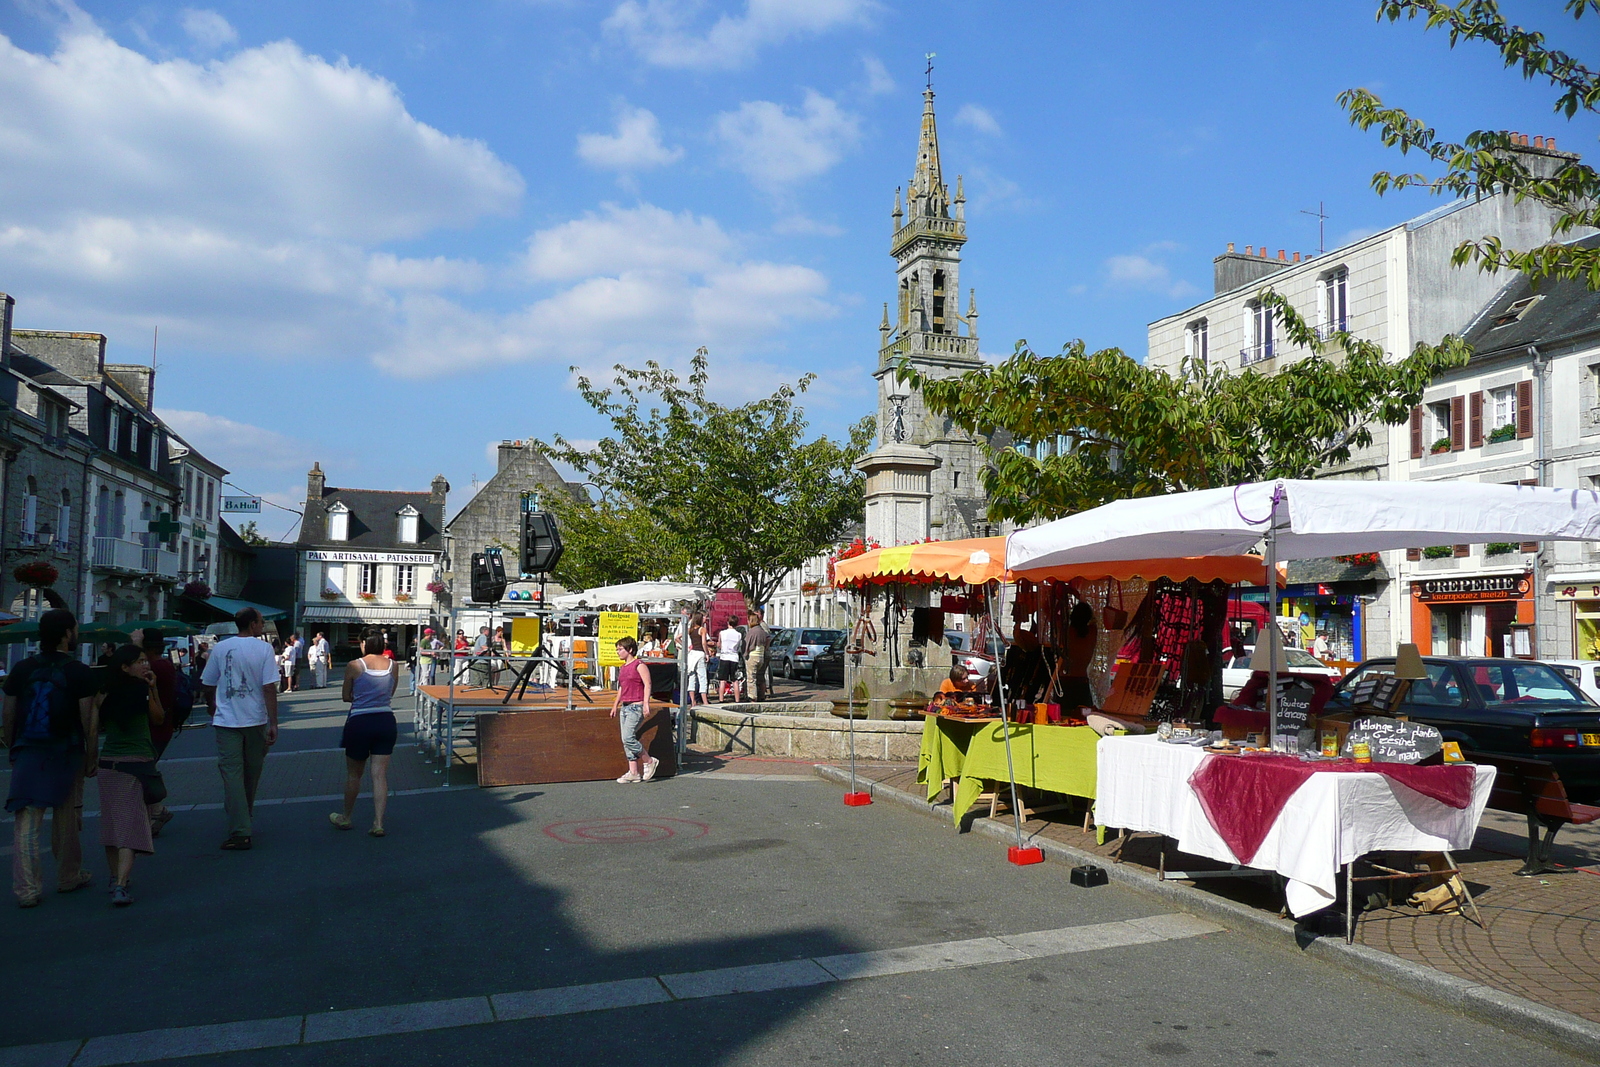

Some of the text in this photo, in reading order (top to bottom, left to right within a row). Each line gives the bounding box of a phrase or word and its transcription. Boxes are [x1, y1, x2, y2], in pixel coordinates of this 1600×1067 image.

[308, 551, 328, 560] PAIN
[332, 552, 379, 562] ARTISANAL
[387, 554, 433, 563] PATISSERIE
[1425, 577, 1514, 593] CREPERIE
[1280, 697, 1310, 709] Poudres
[1349, 732, 1358, 740] et
[1354, 719, 1439, 741] Mélange de plantes
[1398, 748, 1422, 761] main
